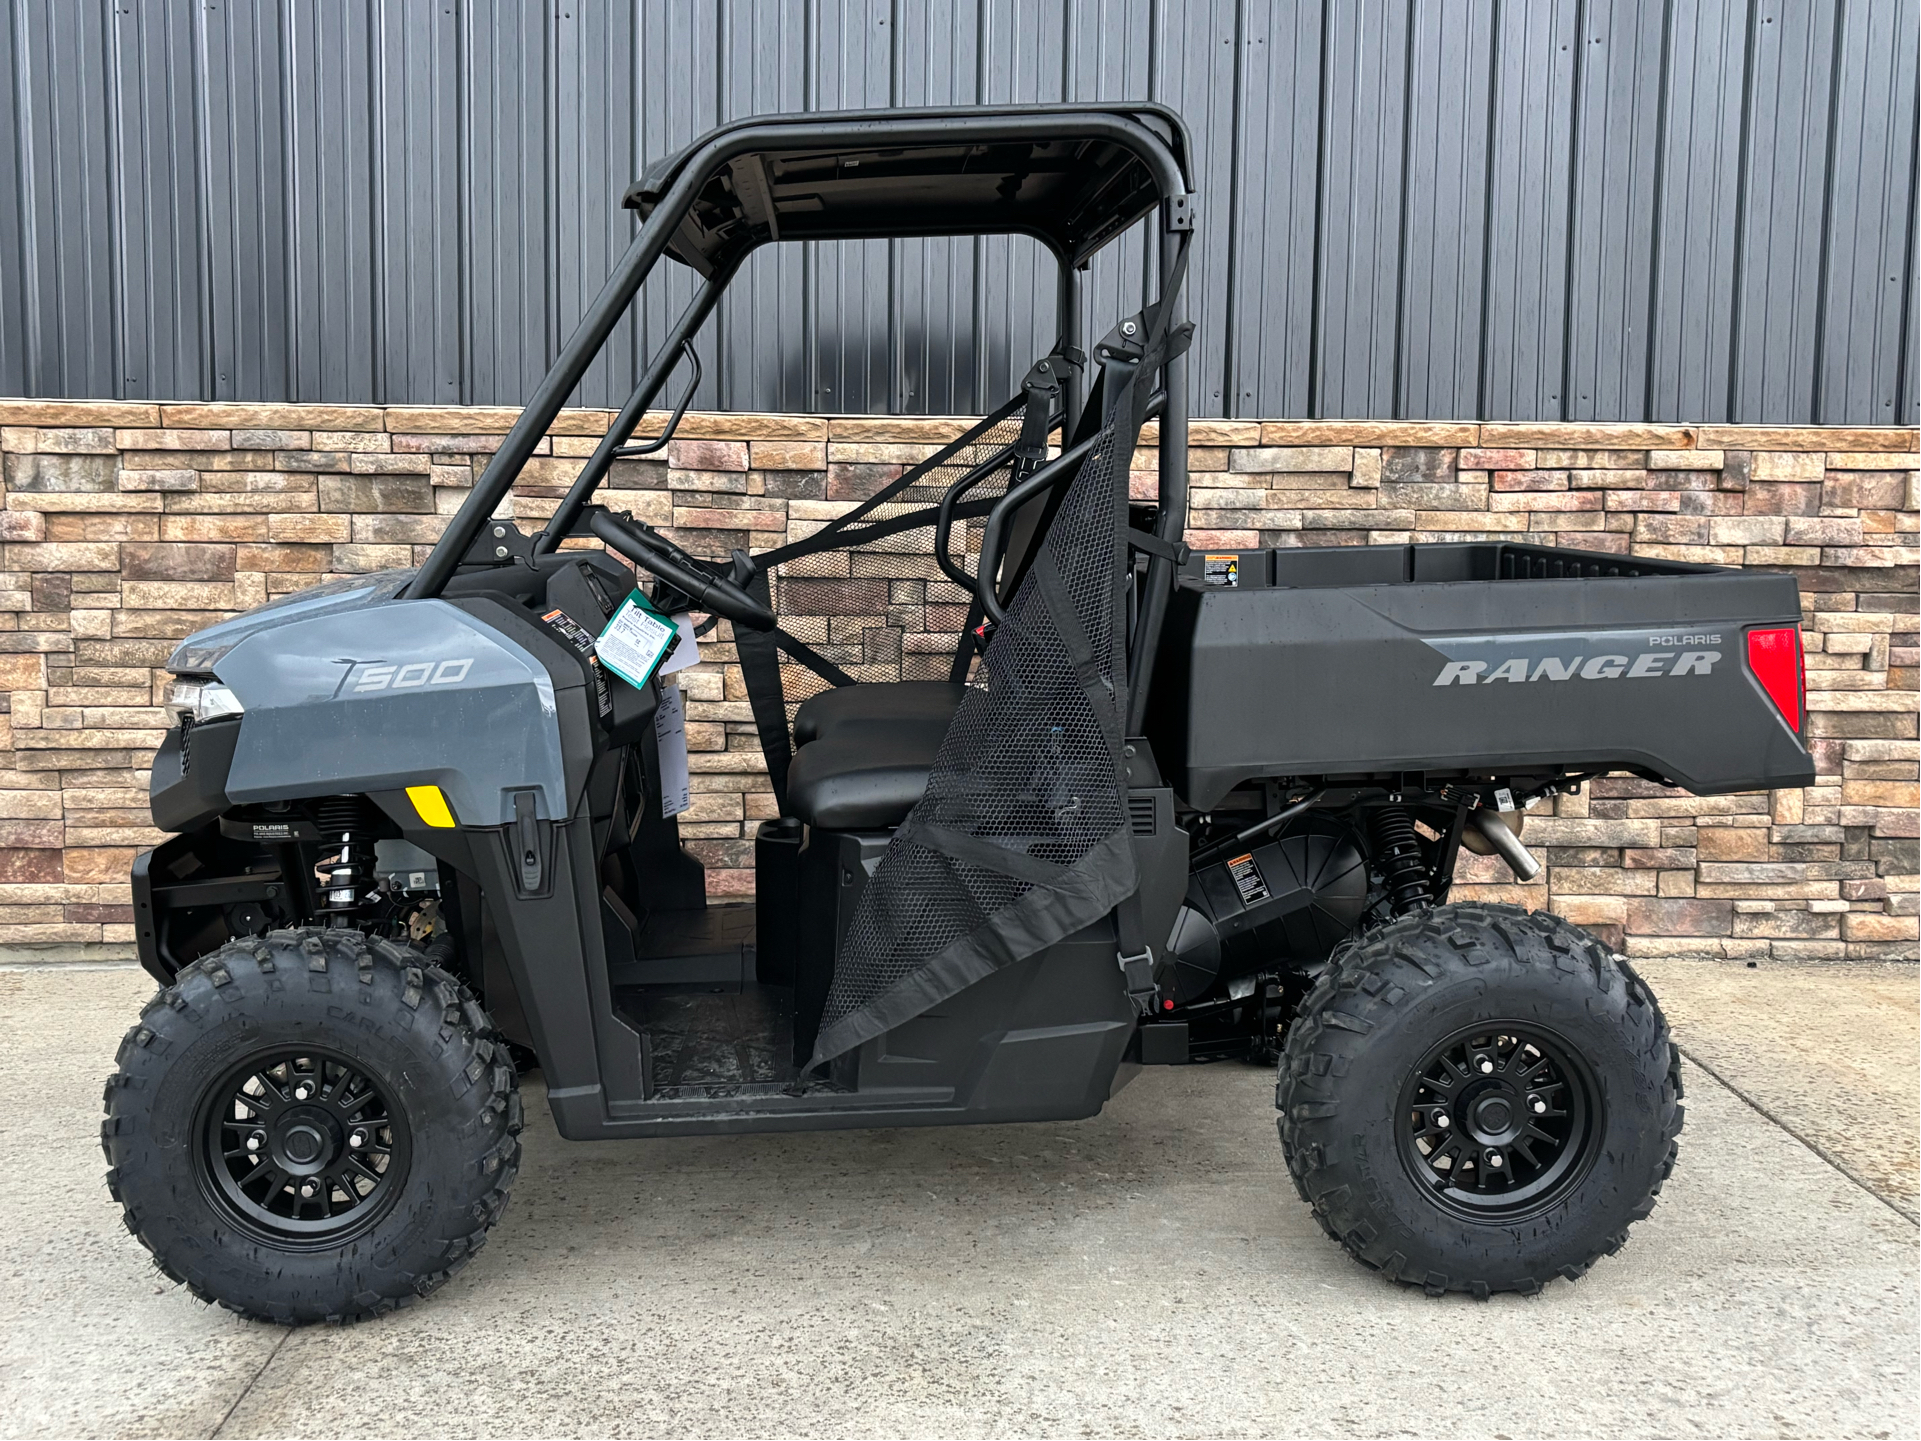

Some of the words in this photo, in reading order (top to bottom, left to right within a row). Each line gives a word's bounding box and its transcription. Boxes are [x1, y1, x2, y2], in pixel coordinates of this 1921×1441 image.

[1648, 634, 1722, 647] POLARIS
[353, 658, 474, 692] 500
[1432, 651, 1723, 687] RANGER
